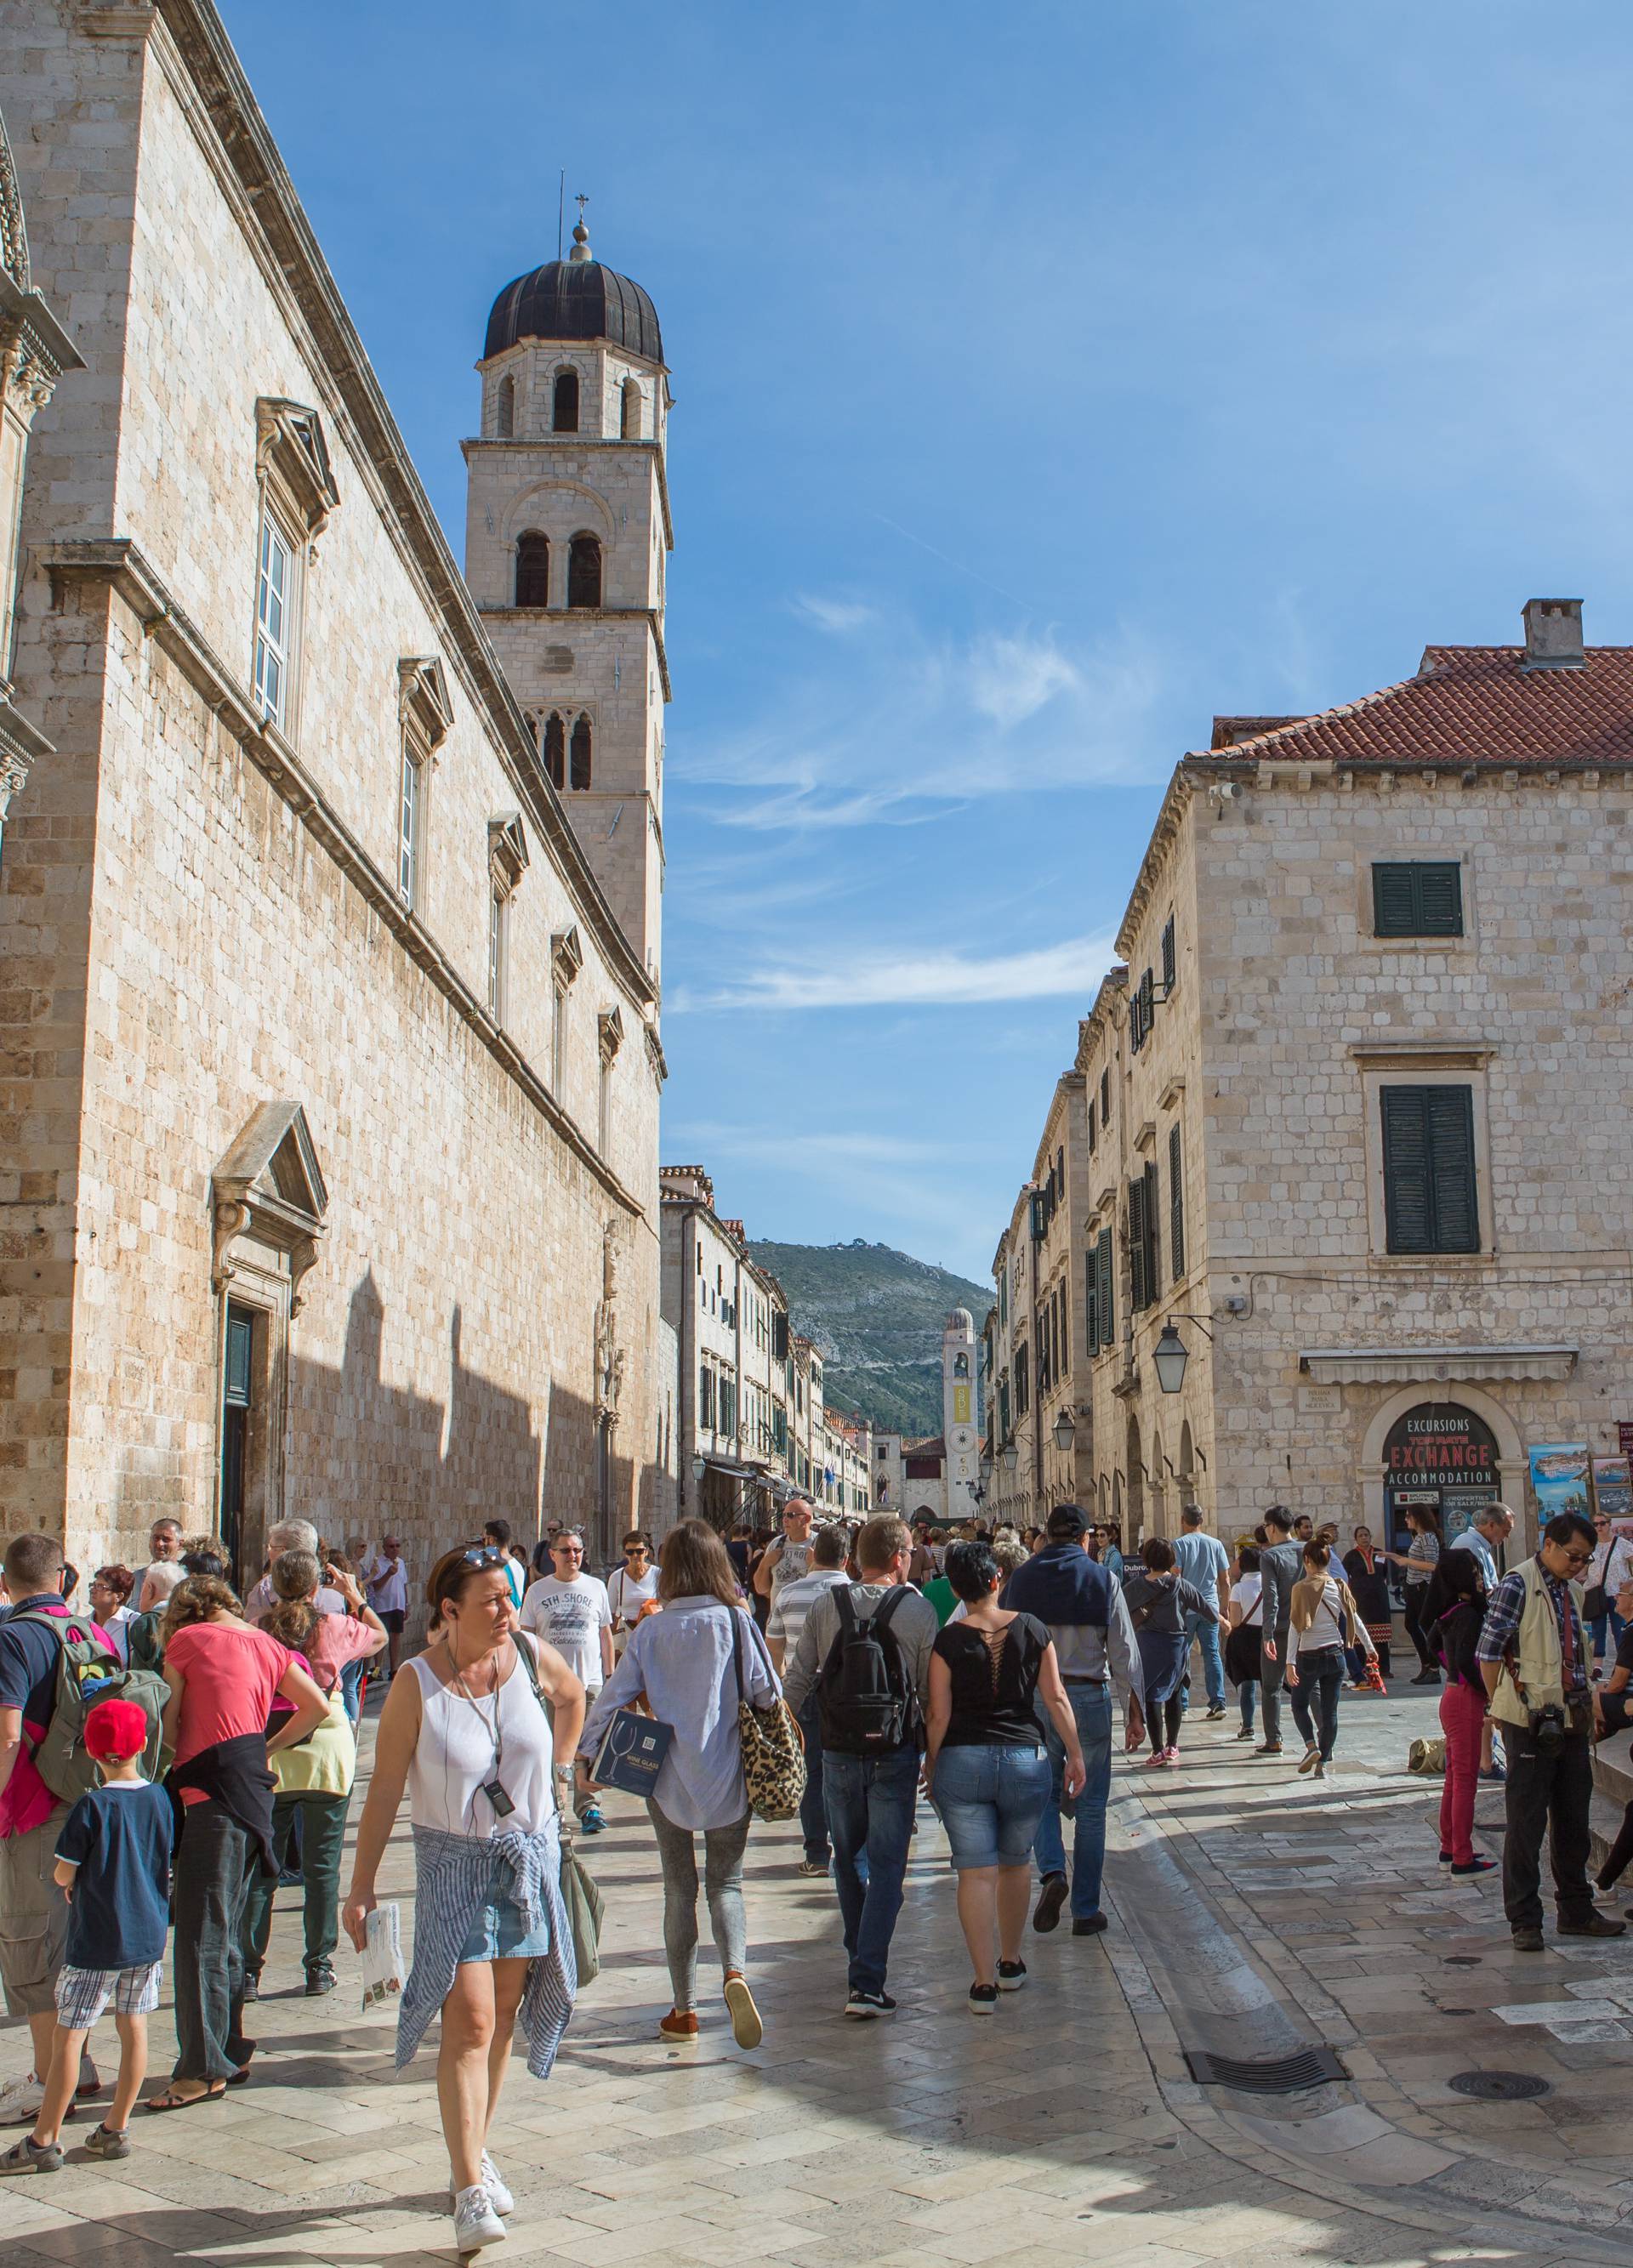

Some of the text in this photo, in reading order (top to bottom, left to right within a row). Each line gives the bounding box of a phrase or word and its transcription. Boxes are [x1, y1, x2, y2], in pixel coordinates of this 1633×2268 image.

[1408, 1418, 1470, 1432] EXCURSIONS
[1408, 1435, 1469, 1445] TOP RATE
[1391, 1445, 1490, 1468] EXCHANGE
[1389, 1471, 1492, 1485] ACCOMMODATION
[641, 1759, 659, 1769] GLASS
